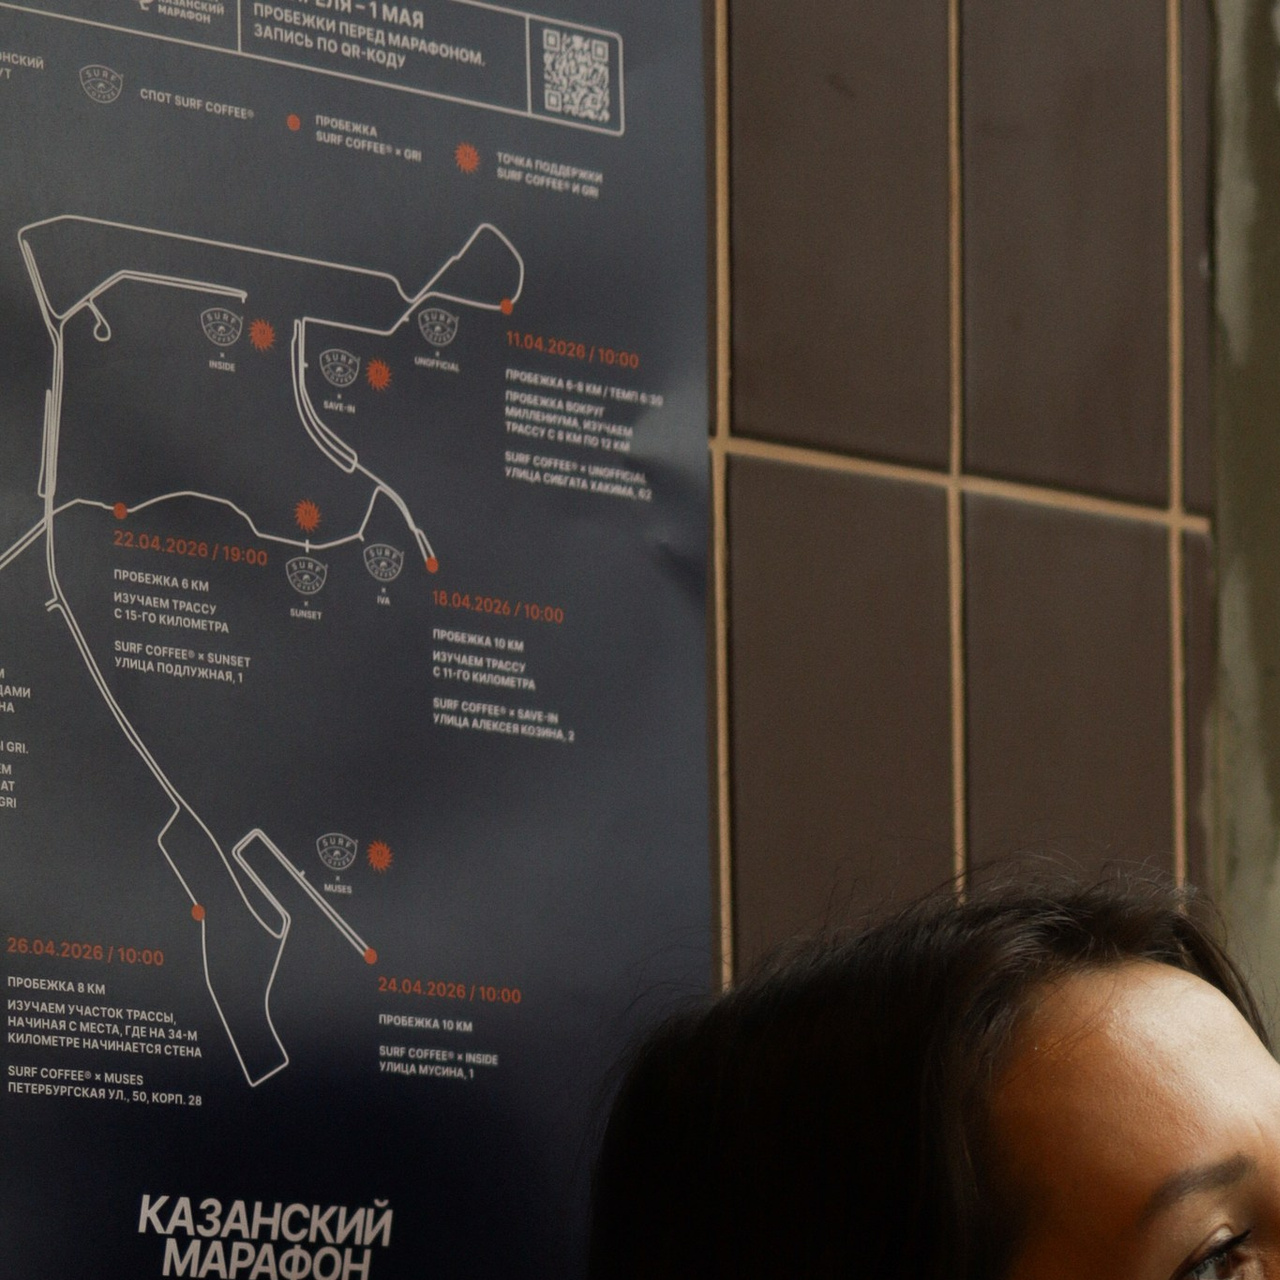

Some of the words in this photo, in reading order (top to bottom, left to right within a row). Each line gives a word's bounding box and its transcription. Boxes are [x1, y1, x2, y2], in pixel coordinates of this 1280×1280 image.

[158, 4, 211, 24] МАРАФОН
[369, 1, 377, 19] 1
[382, 4, 424, 29] МАЯ
[254, 2, 336, 31] ПРОБЕЖКИ
[339, 21, 385, 46] ПЕРЕД
[388, 32, 486, 67] МАРАФОНОМ.
[254, 23, 314, 48] ЗАПИСЬ
[317, 37, 337, 53] ПО
[341, 42, 406, 69] QR-КОДУ
[140, 88, 171, 104] СПОТ
[174, 95, 203, 111] SURF
[315, 114, 378, 137] ПРОБЕЖКА
[315, 131, 344, 145] SURF
[403, 149, 422, 162] GRI
[497, 151, 533, 170] ТОЧКА
[535, 159, 603, 184] ПОДДЕРЖКИ
[497, 168, 523, 183] SURF
[206, 312, 237, 325] SURF
[423, 312, 453, 325] SURF
[209, 360, 236, 372] INSIDE
[325, 353, 354, 365] SURF
[414, 356, 460, 373] UNOFFICIAL
[599, 348, 639, 369] 10:00
[505, 368, 564, 389] ПРОБЕЖКА
[585, 382, 602, 396] КМ
[609, 386, 638, 403] ТЕМП
[505, 390, 564, 411] ПРОБЕЖКА
[566, 401, 605, 417] ВОКРУГ
[505, 420, 545, 438] ТРАССУ
[565, 431, 582, 445] КМ
[584, 434, 599, 447] ПО
[613, 439, 631, 452] КМ
[582, 419, 634, 437] ИЗУЧАЕМ
[505, 450, 531, 464] SURF
[588, 465, 647, 485] UNOFFICIAL
[505, 466, 541, 483] УЛИЦА
[543, 471, 588, 490] СИБГАТА
[113, 530, 208, 558] 22.04.2026
[223, 545, 268, 567] 19:00
[369, 547, 399, 560] SURF
[291, 560, 322, 574] SURF
[113, 568, 178, 589] ПРОБЕЖКА
[181, 578, 189, 590] 6
[191, 579, 209, 592] КМ
[113, 592, 170, 609] ИЗУЧАЕМ
[172, 598, 217, 616] ТРАССУ
[377, 595, 391, 606] IVA
[433, 589, 511, 616] 18.04.2026
[524, 603, 564, 625] 10:00
[114, 608, 122, 619] С
[125, 609, 157, 625] 15-ГО
[159, 613, 230, 634] КИЛОМЕТРА
[290, 608, 323, 620] SUNSET
[432, 628, 492, 648] ПРОБЕЖКА
[494, 637, 505, 649] 10
[507, 639, 524, 653] КМ
[114, 640, 143, 654] SURF
[207, 652, 251, 668] SUNSET
[432, 650, 484, 667] ИЗУЧАЕМ
[486, 657, 526, 673] ТРАССУ
[115, 656, 154, 673] УЛИЦА
[157, 661, 236, 684] ПОДЛУЖНАЯ,
[238, 671, 243, 684] 1
[432, 666, 441, 677] С
[443, 667, 470, 681] 11-ГО
[472, 671, 536, 691] КИЛОМЕТРА
[432, 697, 460, 710] SURF
[517, 708, 559, 724] SAVE-IN
[433, 713, 469, 728] УЛИЦА
[472, 718, 519, 734] АЛЕКСЕЯ
[568, 730, 575, 742] 2
[6, 741, 29, 754] GRI.
[321, 837, 352, 849] SURF
[324, 883, 352, 894] MUSES
[7, 937, 103, 961] 26.04.2026
[118, 947, 165, 967] 10:00
[8, 976, 75, 993] ПРОБЕЖКА
[78, 983, 84, 993] 8
[87, 983, 106, 995] КМ
[378, 976, 466, 999] 24.04.2026
[480, 985, 522, 1004] 10:00
[8, 999, 65, 1015] ИЗУЧАЕМ
[68, 1004, 124, 1020] УЧАСТОК
[126, 1008, 177, 1025] ТРАССЫ,
[378, 1013, 440, 1030] ПРОБЕЖКА
[442, 1019, 454, 1031] 10
[456, 1020, 473, 1032] КМ
[8, 1016, 66, 1031] НАЧИНАЯ
[69, 1020, 77, 1031] С
[79, 1022, 123, 1038] МЕСТА,
[125, 1025, 147, 1039] ГДЕ
[149, 1028, 165, 1040] НА
[168, 1029, 198, 1041] 34-М
[8, 1032, 80, 1049] КИЛОМЕТРЕ
[83, 1039, 162, 1055] НАЧИНАЕТСЯ
[164, 1045, 202, 1058] СТЕНА
[379, 1045, 406, 1058] SURF
[465, 1052, 498, 1066] INSIDE
[8, 1065, 38, 1078] SURF
[104, 1073, 144, 1086] MUSES
[379, 1061, 416, 1076] УЛИЦА
[418, 1064, 467, 1080] МУСИНА,
[469, 1067, 474, 1079] 1
[8, 1082, 106, 1099] ПЕТЕРБУРГСКАЯ
[108, 1089, 130, 1103] УЛ.,
[132, 1091, 150, 1104] 50,
[152, 1092, 186, 1105] КОРП.
[188, 1094, 202, 1106] 28
[138, 1194, 394, 1247] КАЗАНСКИЙ
